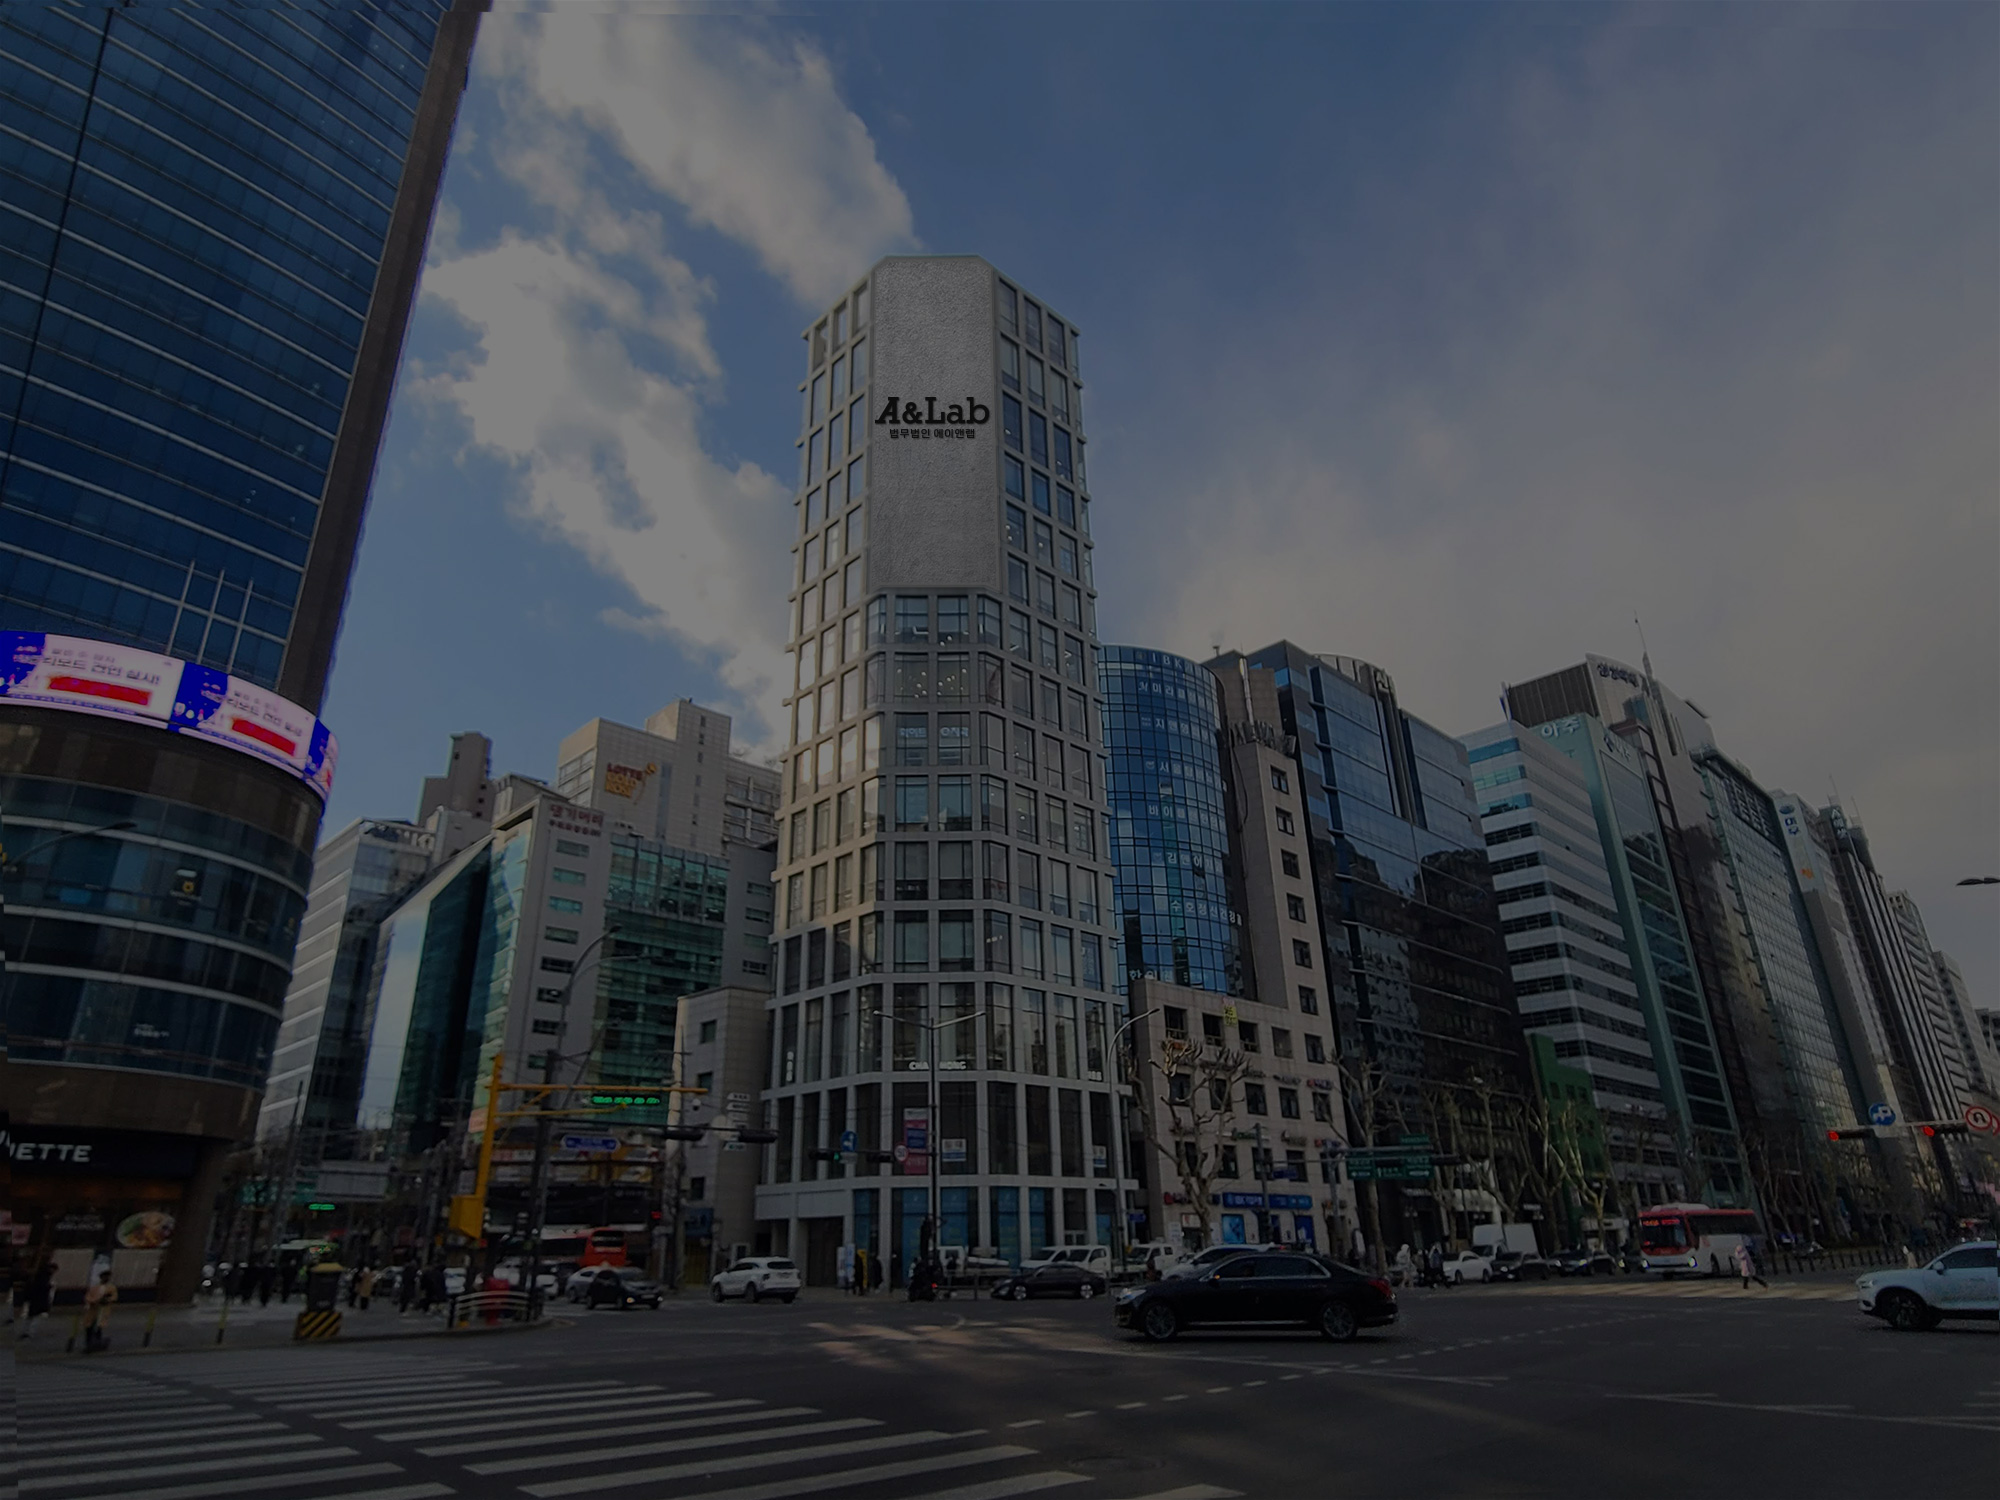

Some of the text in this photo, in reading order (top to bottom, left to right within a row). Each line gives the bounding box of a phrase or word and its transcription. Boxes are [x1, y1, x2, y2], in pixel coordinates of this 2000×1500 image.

[874, 396, 990, 424] A&Lab
[889, 428, 975, 439] 법무법인 에이앤랩
[606, 771, 637, 789] GOLD
[607, 763, 643, 780] LOTTE
